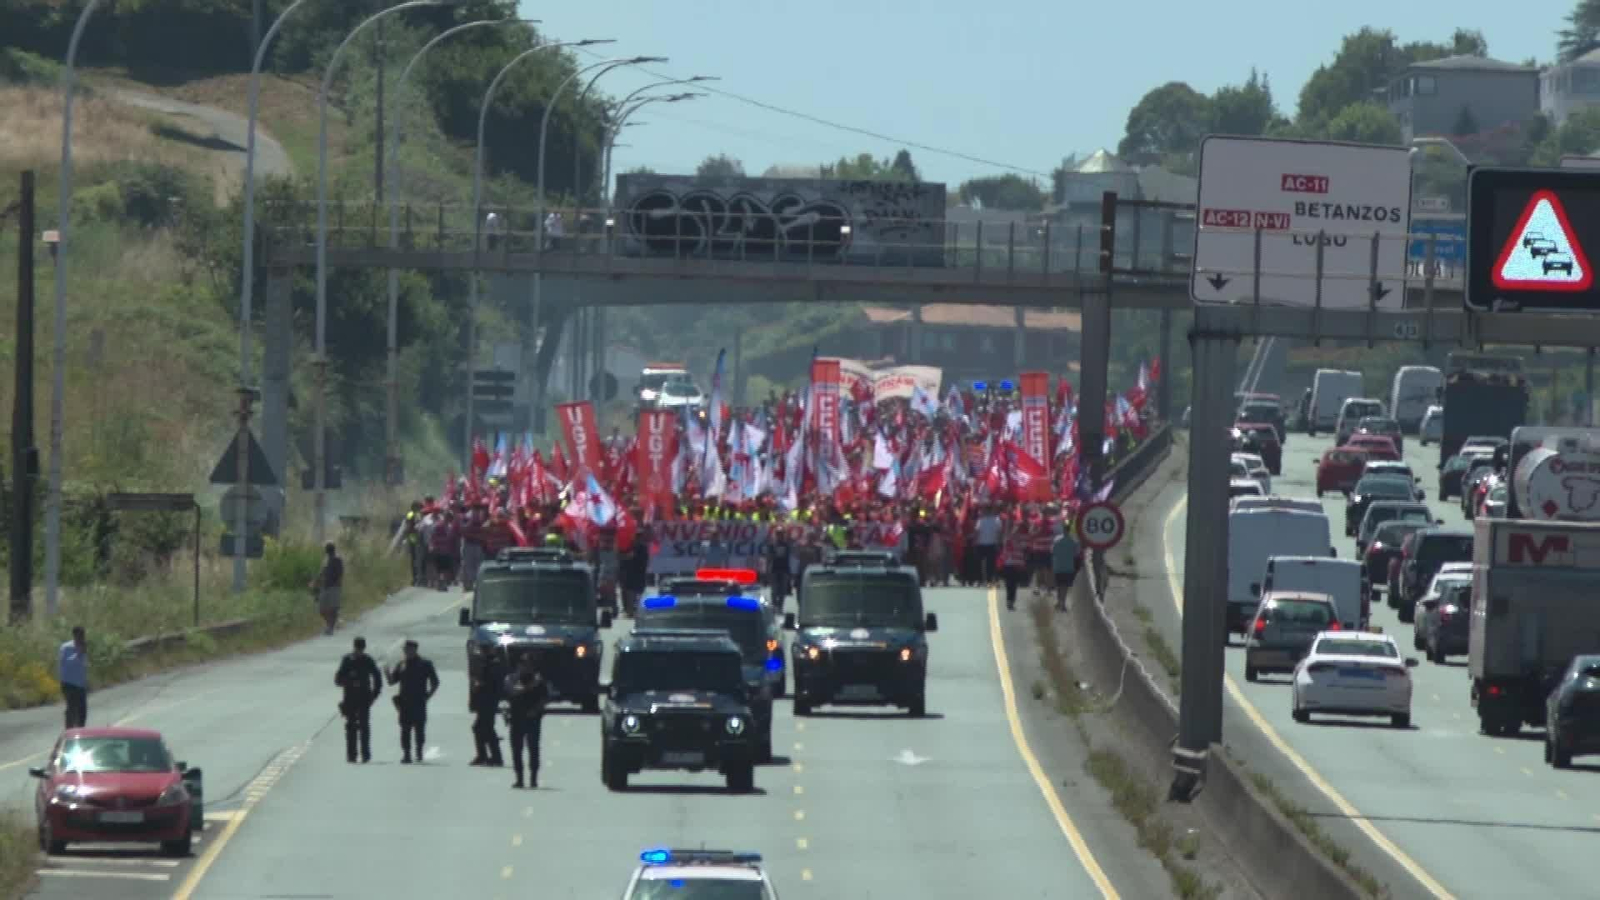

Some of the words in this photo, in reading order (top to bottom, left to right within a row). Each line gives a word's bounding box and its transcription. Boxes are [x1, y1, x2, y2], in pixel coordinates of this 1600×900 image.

[1284, 177, 1328, 192] AC-11
[1205, 210, 1249, 226] AC-12
[1256, 213, 1290, 228] N-VI
[1295, 201, 1401, 223] BETANZOS
[566, 405, 588, 464] UGT
[648, 413, 665, 473] UGT
[1028, 410, 1044, 467] CCO
[650, 520, 758, 541] NVENIO
[1086, 516, 1115, 534] 80
